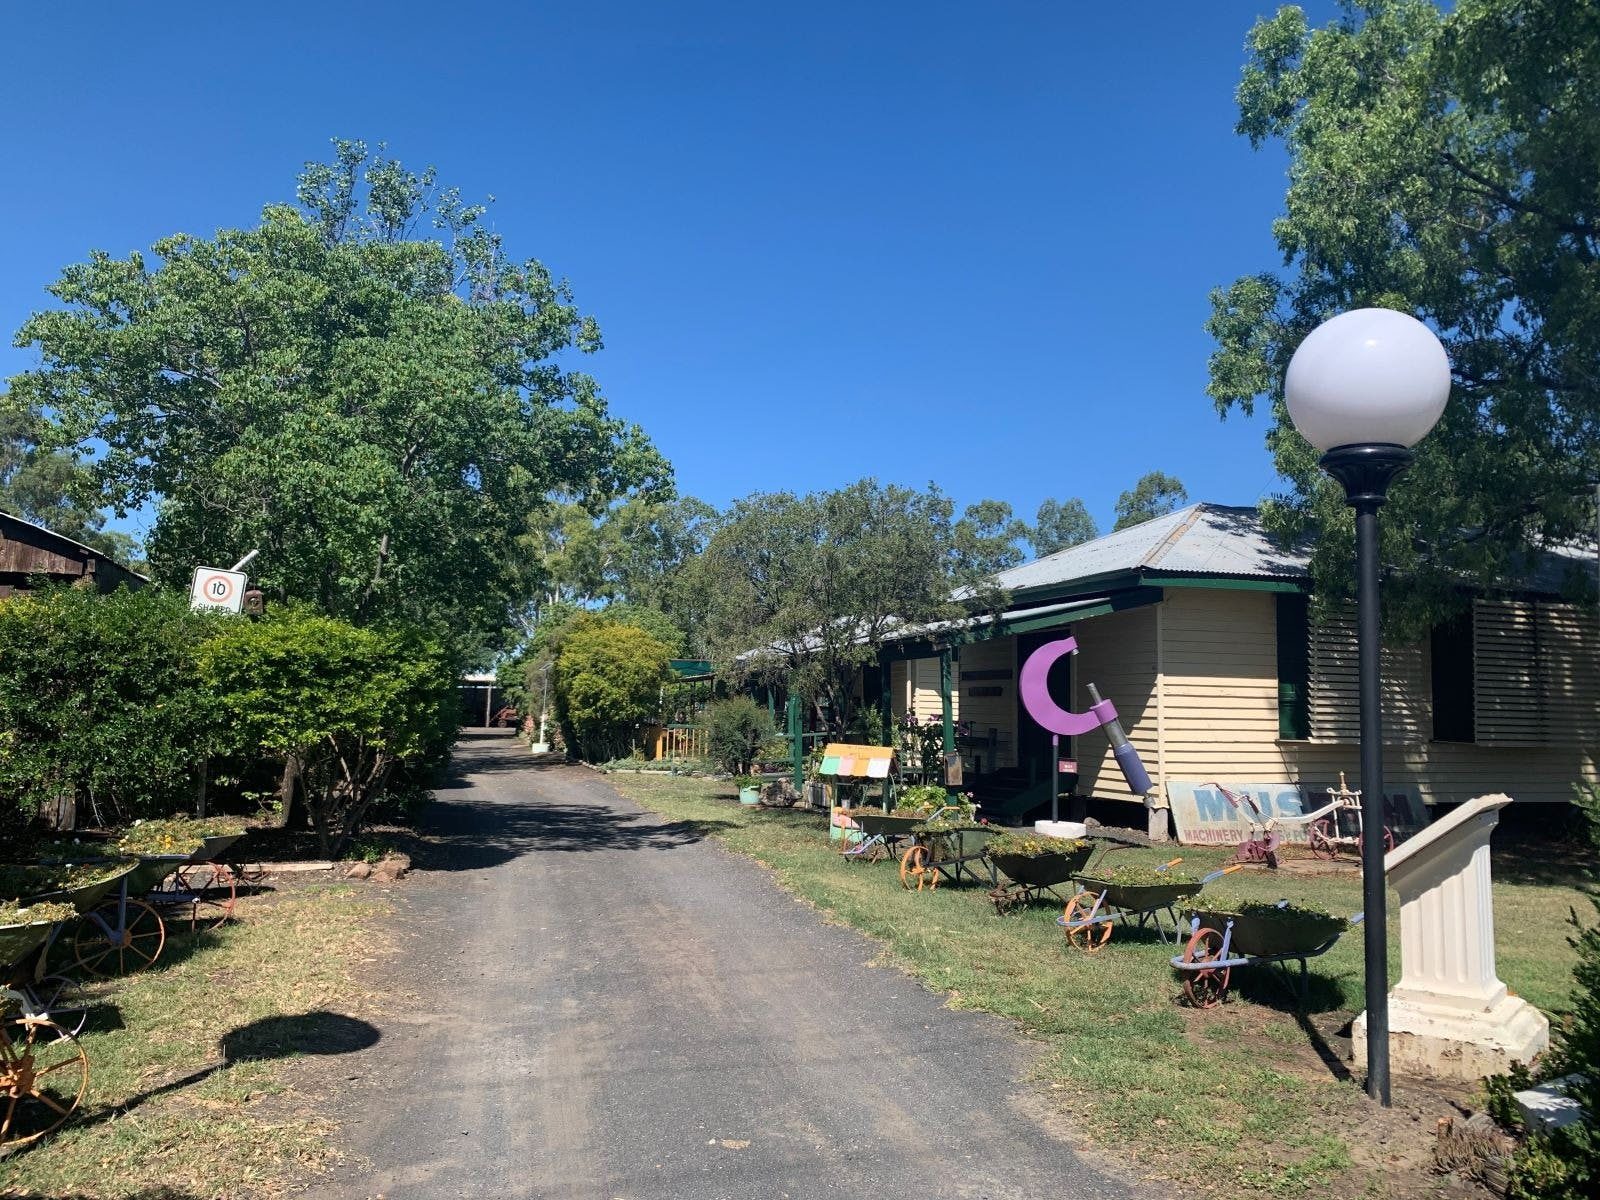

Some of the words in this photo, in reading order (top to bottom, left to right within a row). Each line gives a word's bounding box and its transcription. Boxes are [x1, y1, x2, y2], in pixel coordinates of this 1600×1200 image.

[212, 583, 226, 596] 10
[1193, 789, 1416, 828] MUSM
[1184, 829, 1243, 842] MACHINERY
